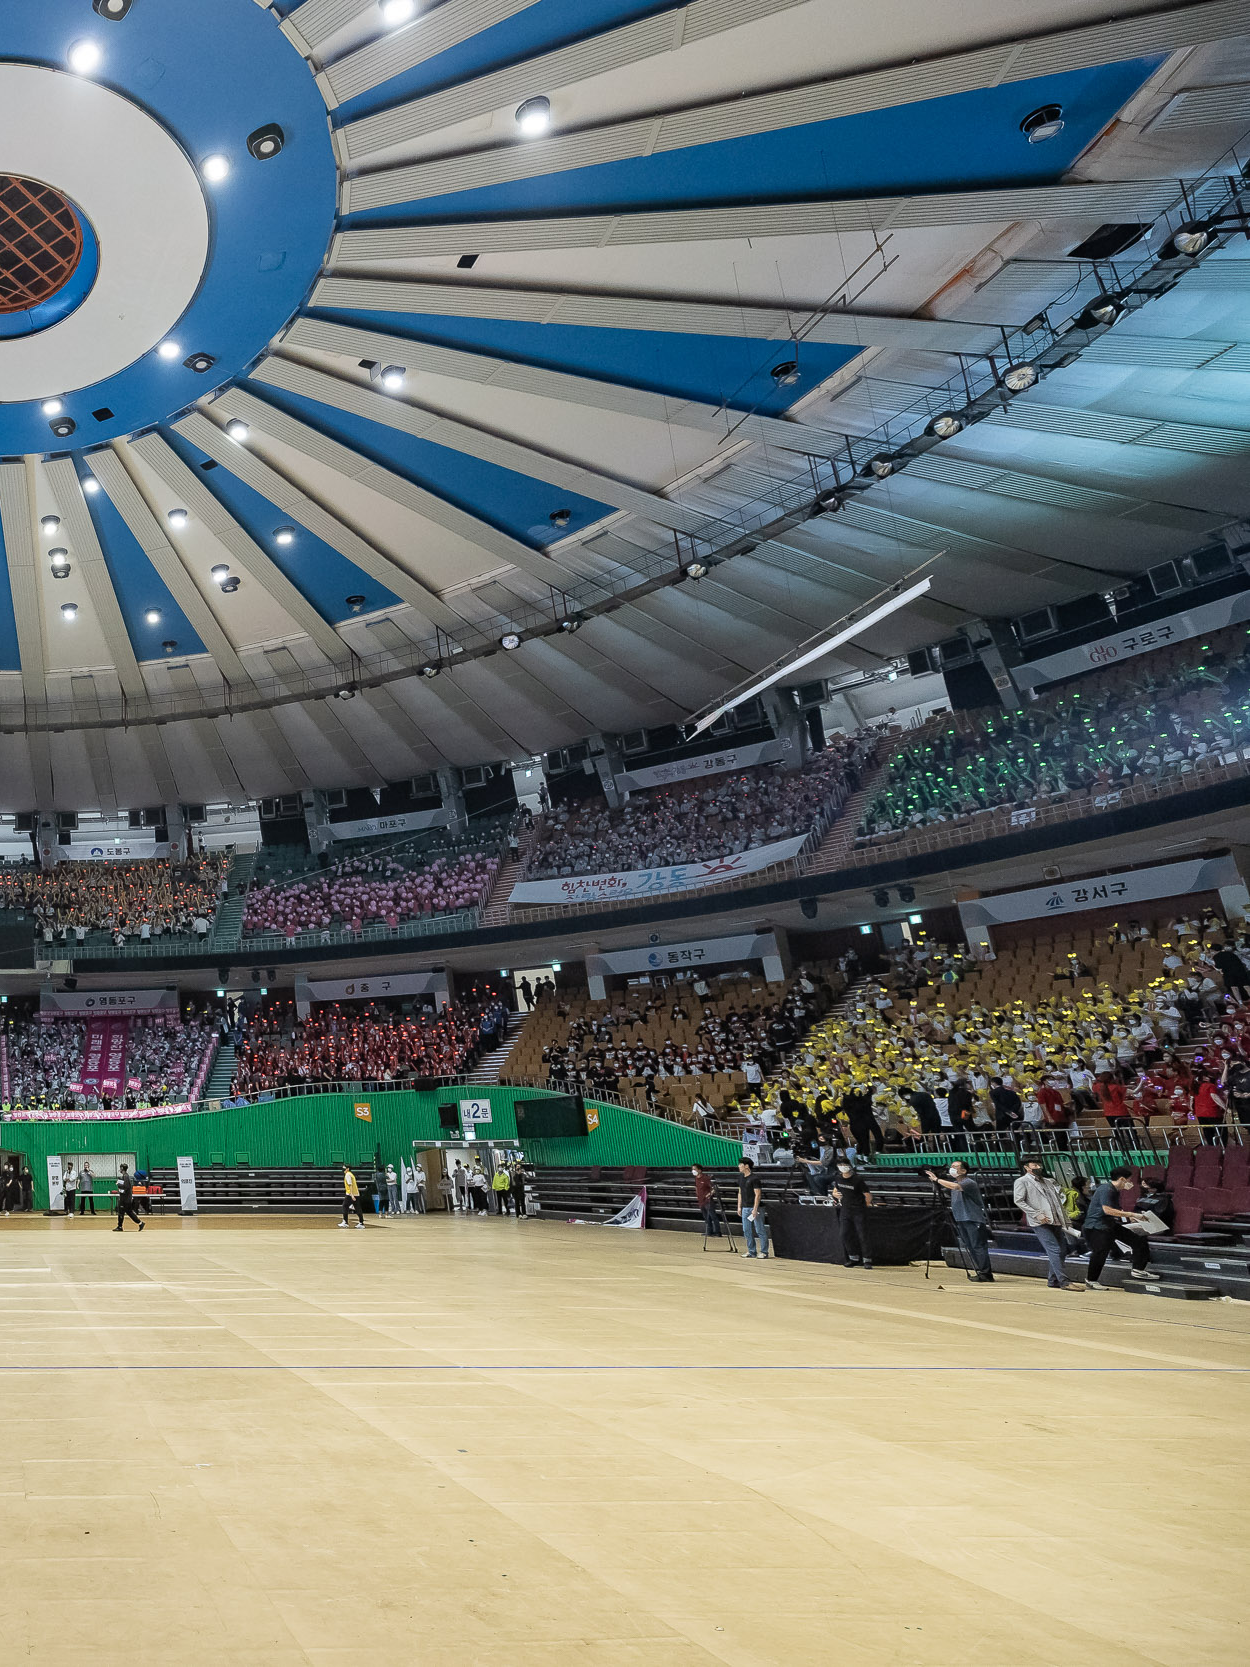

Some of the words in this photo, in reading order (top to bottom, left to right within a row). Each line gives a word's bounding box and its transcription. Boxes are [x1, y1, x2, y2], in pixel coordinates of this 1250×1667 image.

[1121, 625, 1175, 651] 구로구
[703, 753, 737, 769] 강동구
[379, 818, 406, 830] 마포구
[106, 847, 131, 856] 도봉구
[636, 867, 687, 891] 강동
[1071, 881, 1129, 903] 강서구
[667, 948, 706, 964] 동작구
[99, 996, 136, 1005] 영등포구
[356, 1106, 369, 1117] S3
[586, 1113, 599, 1125] S4
